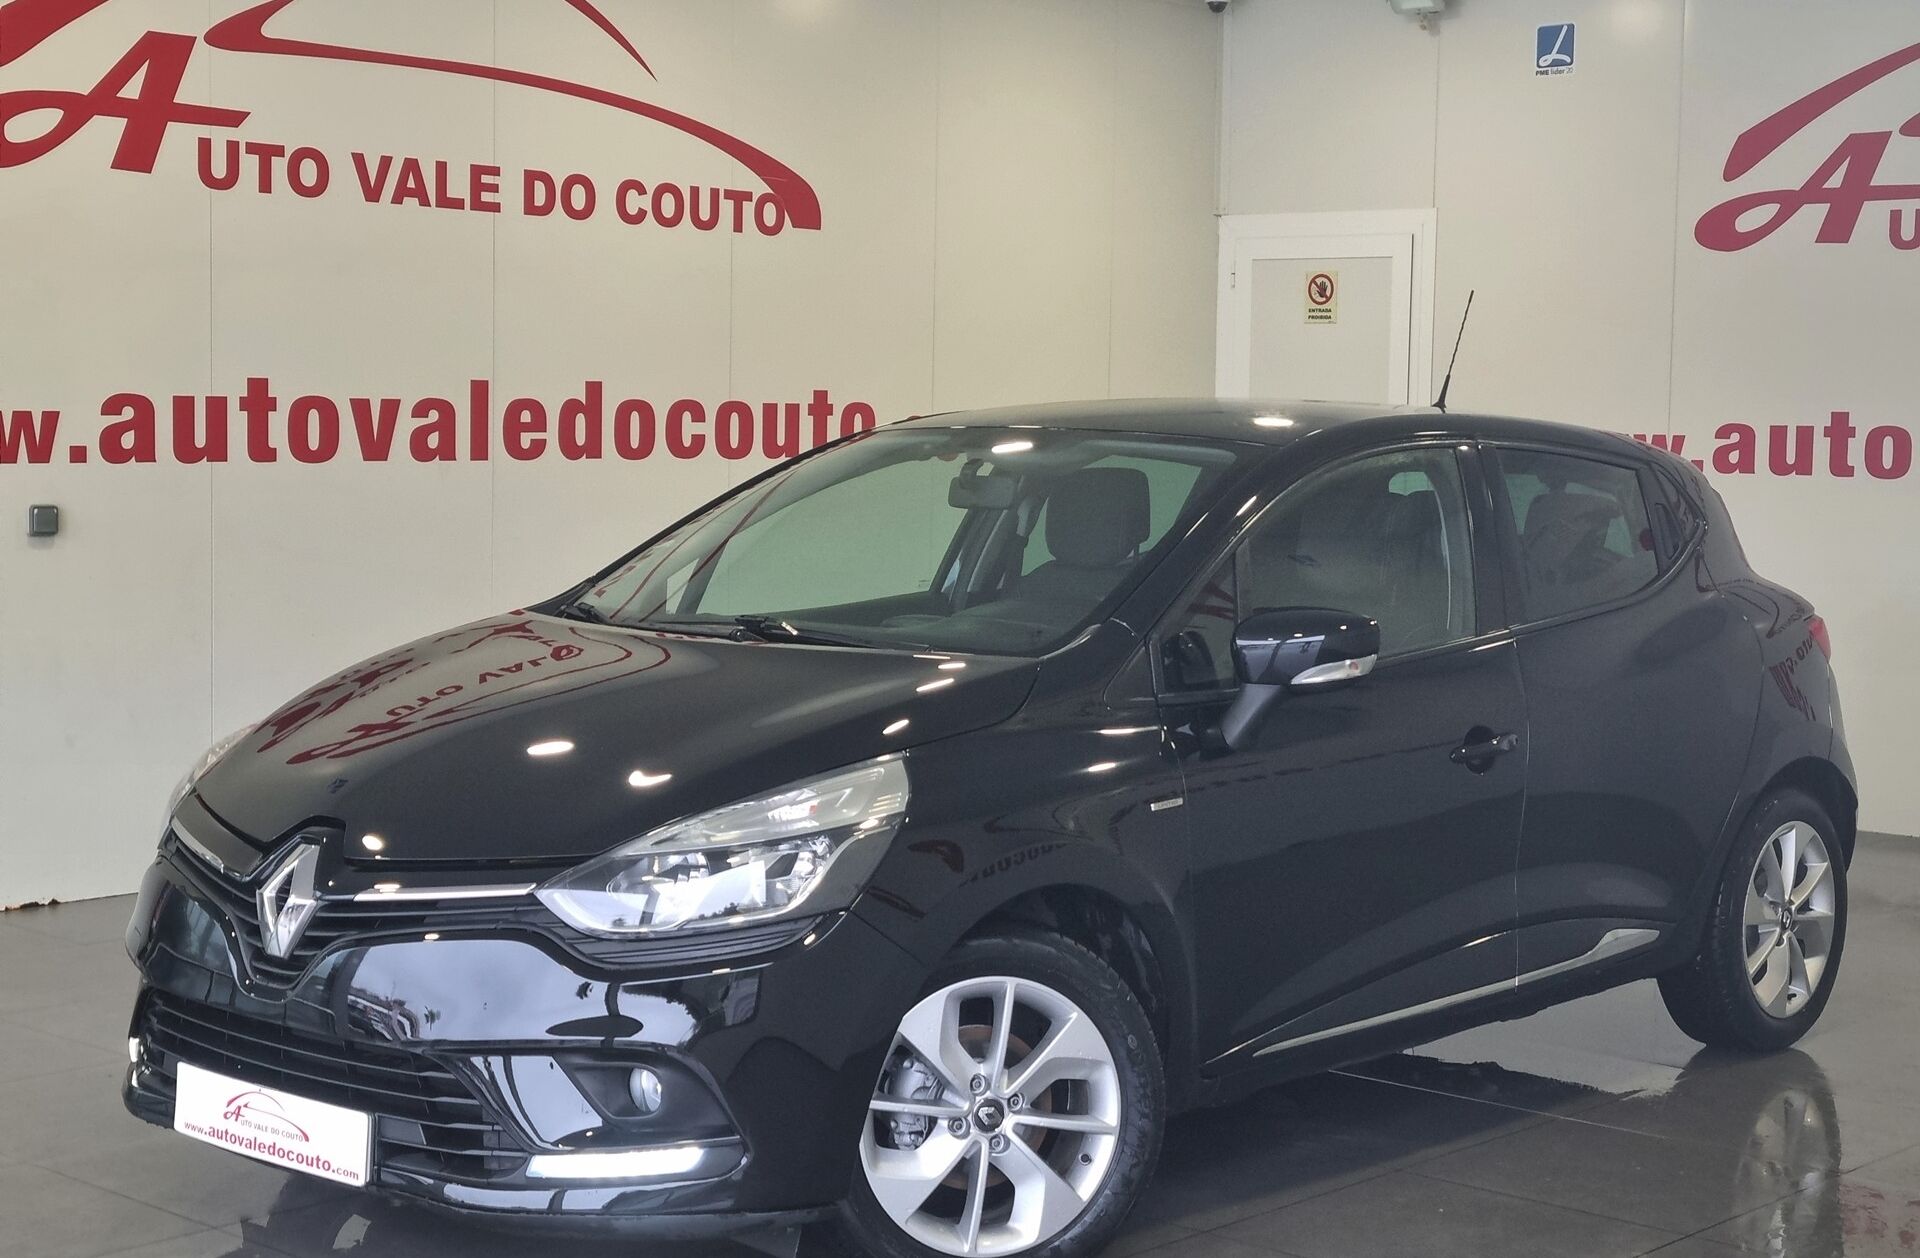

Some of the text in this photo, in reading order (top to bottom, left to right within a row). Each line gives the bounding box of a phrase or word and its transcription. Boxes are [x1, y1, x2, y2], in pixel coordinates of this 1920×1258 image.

[351, 152, 501, 213] VALE
[523, 169, 597, 221] DO
[616, 178, 786, 236] COUTO
[184, 1121, 360, 1181] www.autovaledocouto.com
[223, 1105, 304, 1142] AUTO VALE DO COUTO
